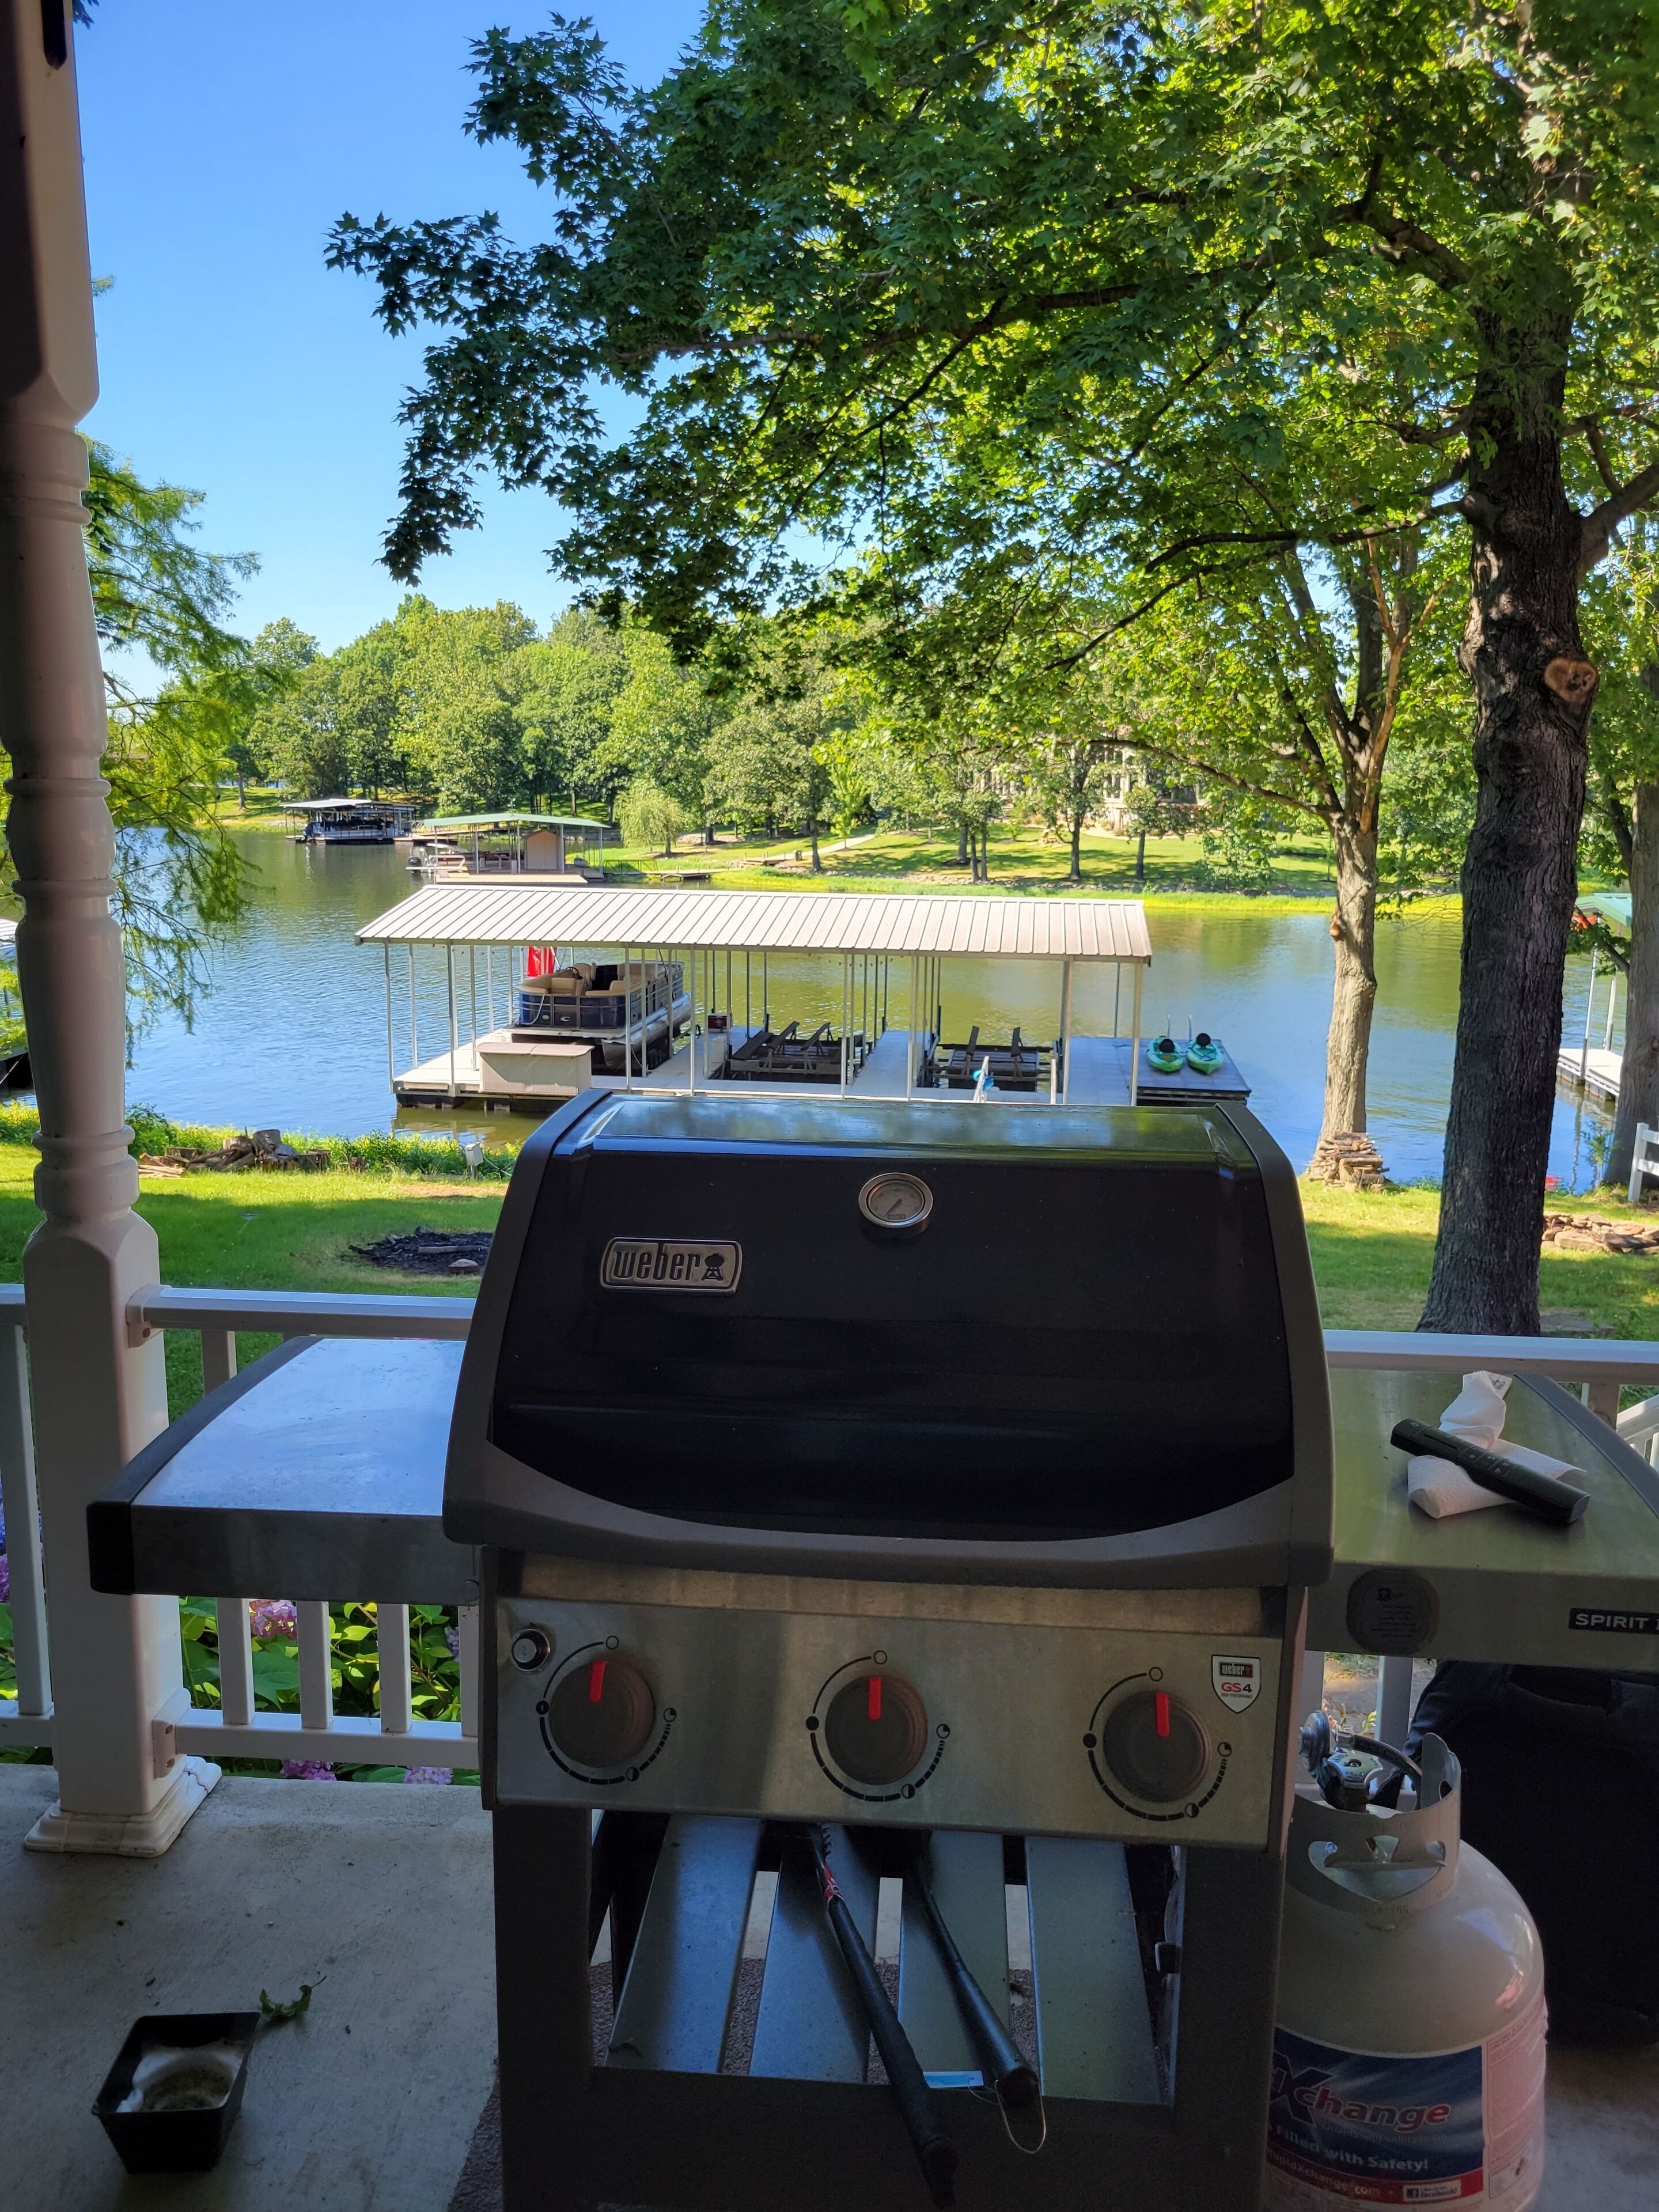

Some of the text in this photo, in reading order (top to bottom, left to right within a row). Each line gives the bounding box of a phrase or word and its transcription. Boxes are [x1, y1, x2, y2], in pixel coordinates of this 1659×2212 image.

[613, 1243, 701, 1281] weber
[1575, 1613, 1650, 1630] SPIRIT
[1222, 1663, 1244, 1676] weber
[1222, 1682, 1253, 1693] GS4
[1277, 2124, 1320, 2153] Filled
[1324, 2147, 1365, 2166] with
[1368, 2156, 1428, 2172] Safety!
